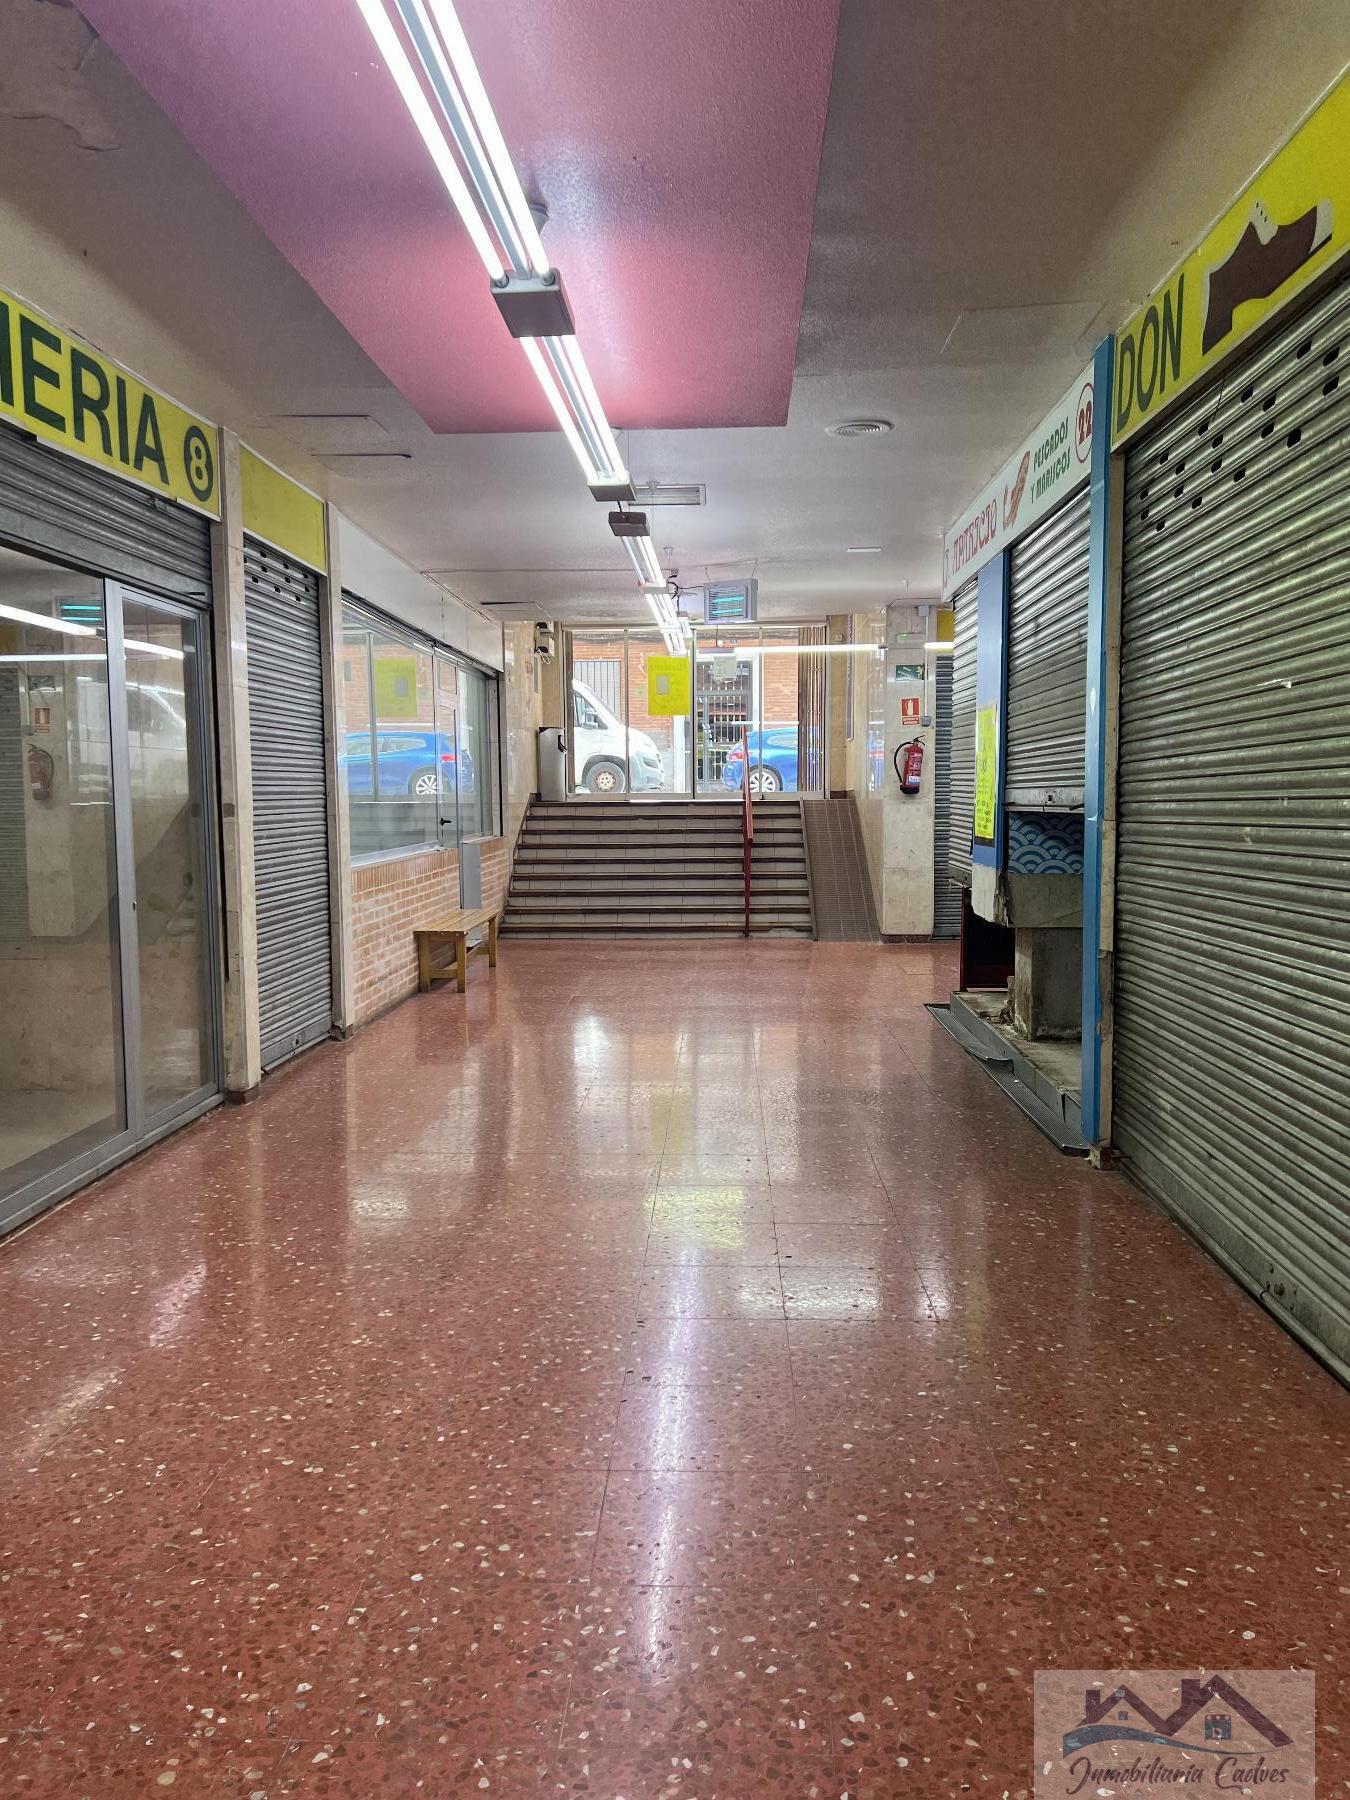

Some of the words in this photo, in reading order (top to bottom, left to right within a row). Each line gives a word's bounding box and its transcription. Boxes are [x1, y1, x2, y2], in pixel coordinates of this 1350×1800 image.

[1117, 273, 1184, 434] DON
[1034, 416, 1069, 472] PESCADOS
[1079, 400, 1093, 446] 22
[188, 431, 210, 495] 8
[1031, 483, 1036, 504] Y
[1036, 446, 1071, 499] MARISCOS
